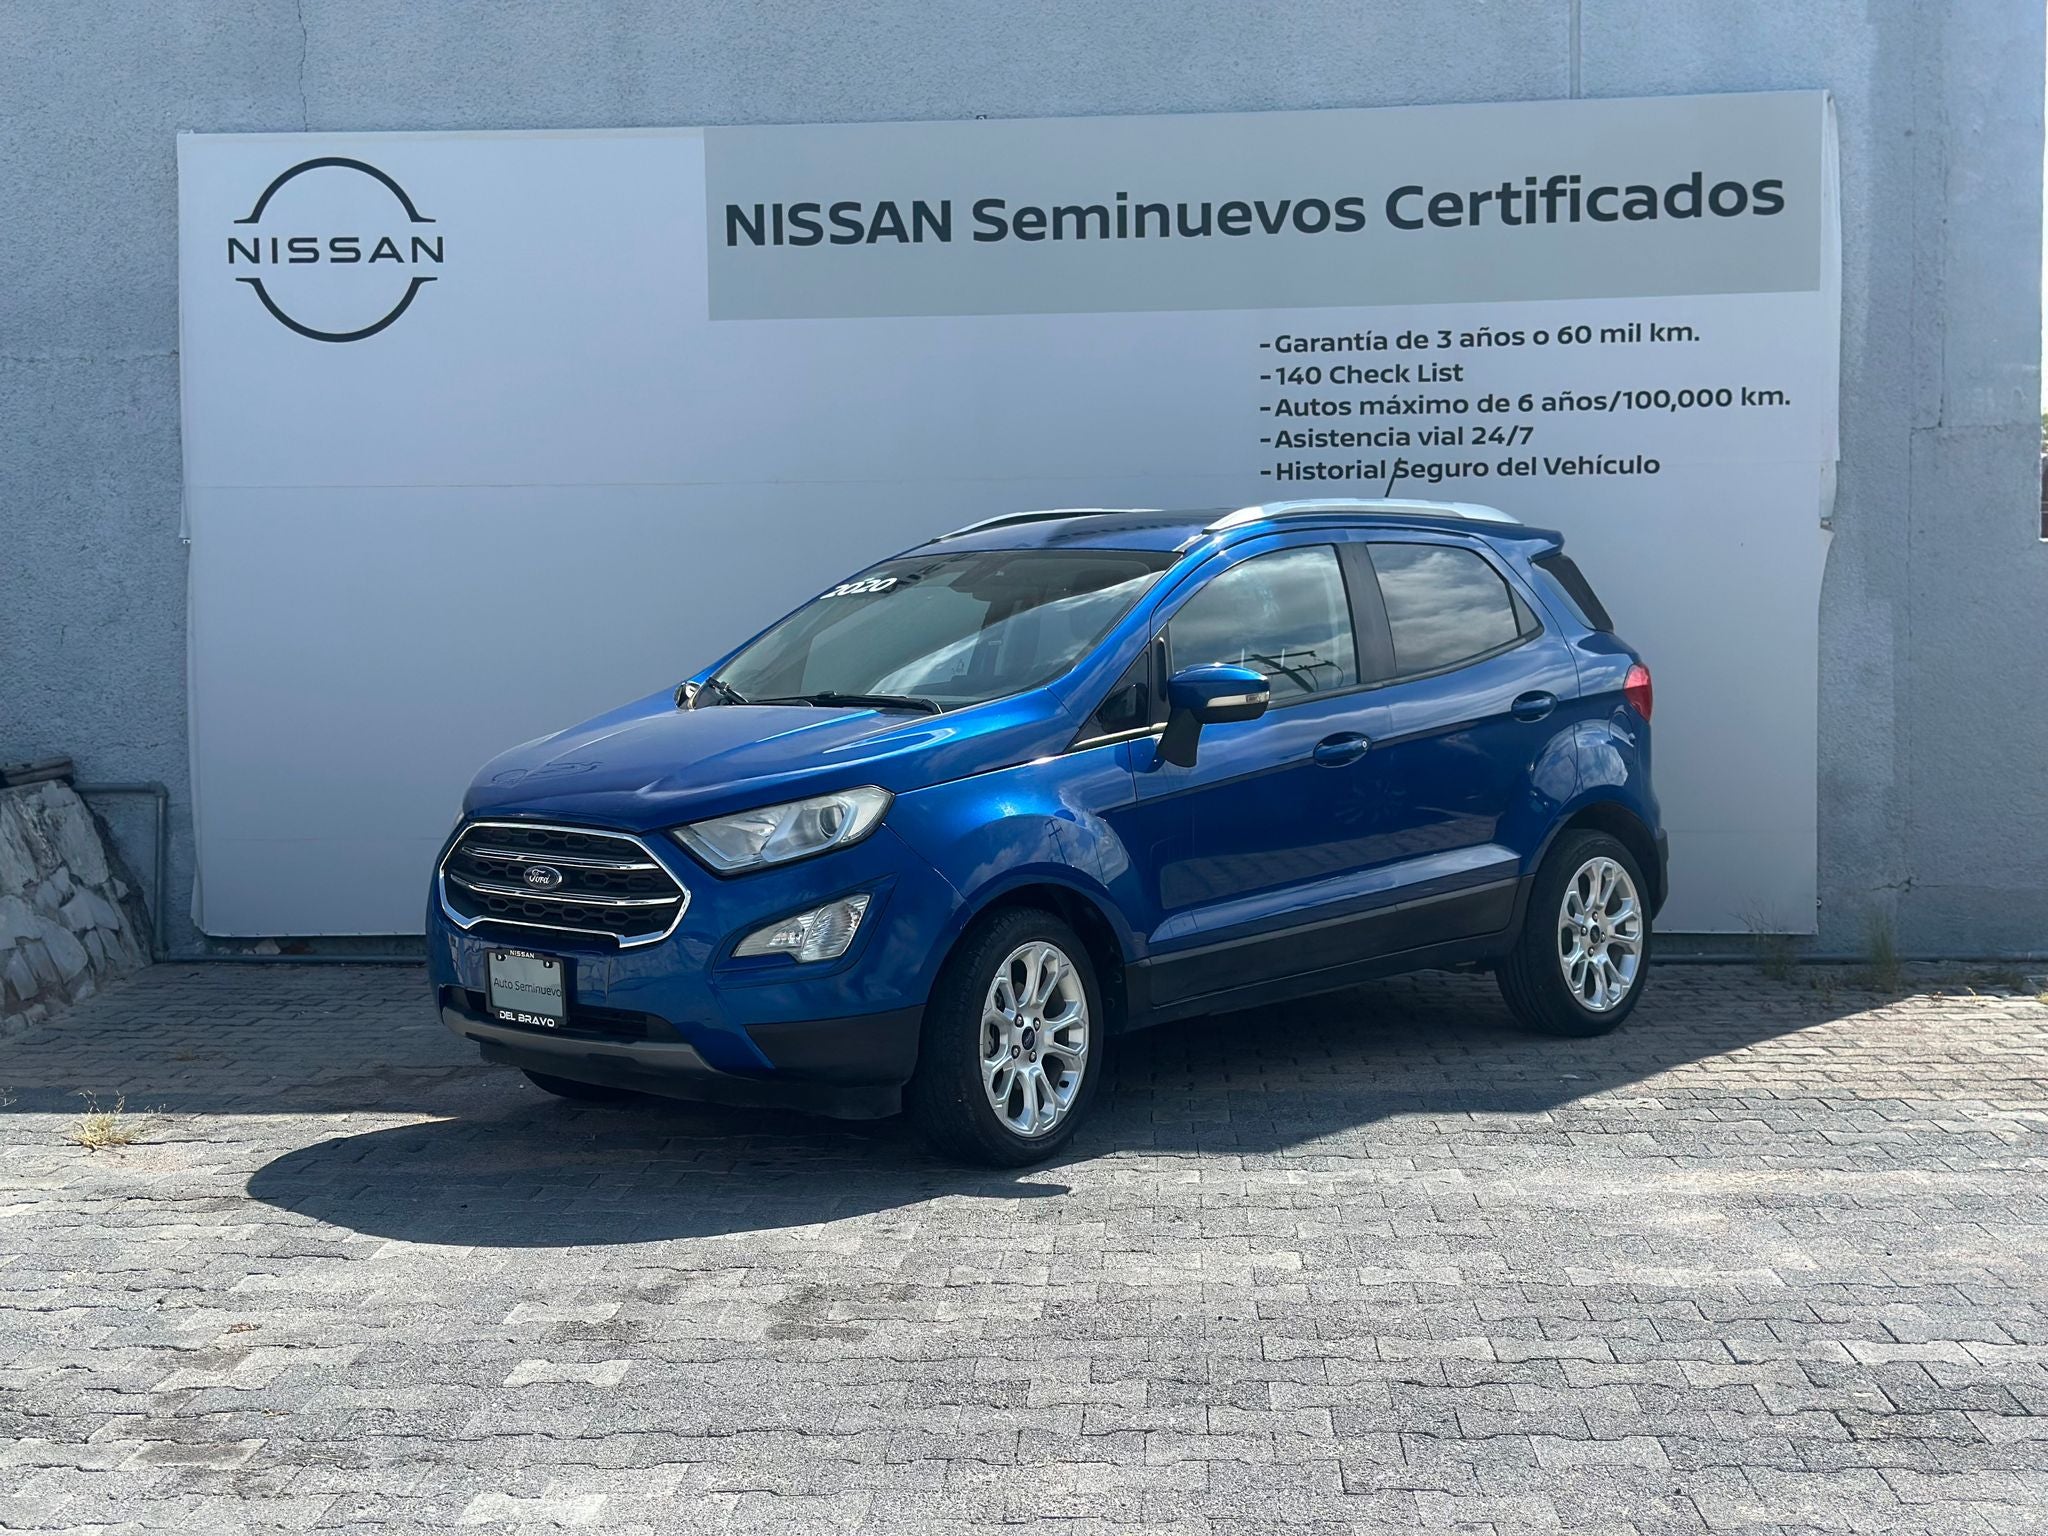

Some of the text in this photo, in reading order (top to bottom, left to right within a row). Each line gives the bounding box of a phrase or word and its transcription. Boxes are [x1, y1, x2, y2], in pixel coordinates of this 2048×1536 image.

[727, 171, 1785, 247] NISSAN Seminuevos Certificados
[228, 236, 444, 264] NISSAN
[1395, 330, 1429, 350] de
[1436, 330, 1452, 349] 3
[1459, 326, 1526, 348] años
[1532, 331, 1550, 346] o
[1557, 325, 1592, 345] 60
[1600, 322, 1641, 344] mil
[1650, 322, 1700, 342] km.
[1329, 363, 1411, 385] Check
[1417, 362, 1464, 383] List
[1359, 394, 1469, 416] máximo
[1477, 393, 1511, 414] de
[1517, 394, 1534, 413] 6
[1541, 388, 1733, 413] años/100,000
[1741, 386, 1791, 406] km.
[1417, 426, 1464, 446] vial
[1471, 425, 1534, 447] 24/7
[1394, 459, 1490, 483] Seguro
[1496, 456, 1537, 477] del
[1543, 454, 1661, 476] Vehículo
[819, 577, 898, 600] 2020
[528, 868, 551, 884] Ford
[509, 950, 535, 959] NISSAN
[494, 977, 563, 998] Auto Seminuevo
[499, 1010, 555, 1028] DEL BRAVO
